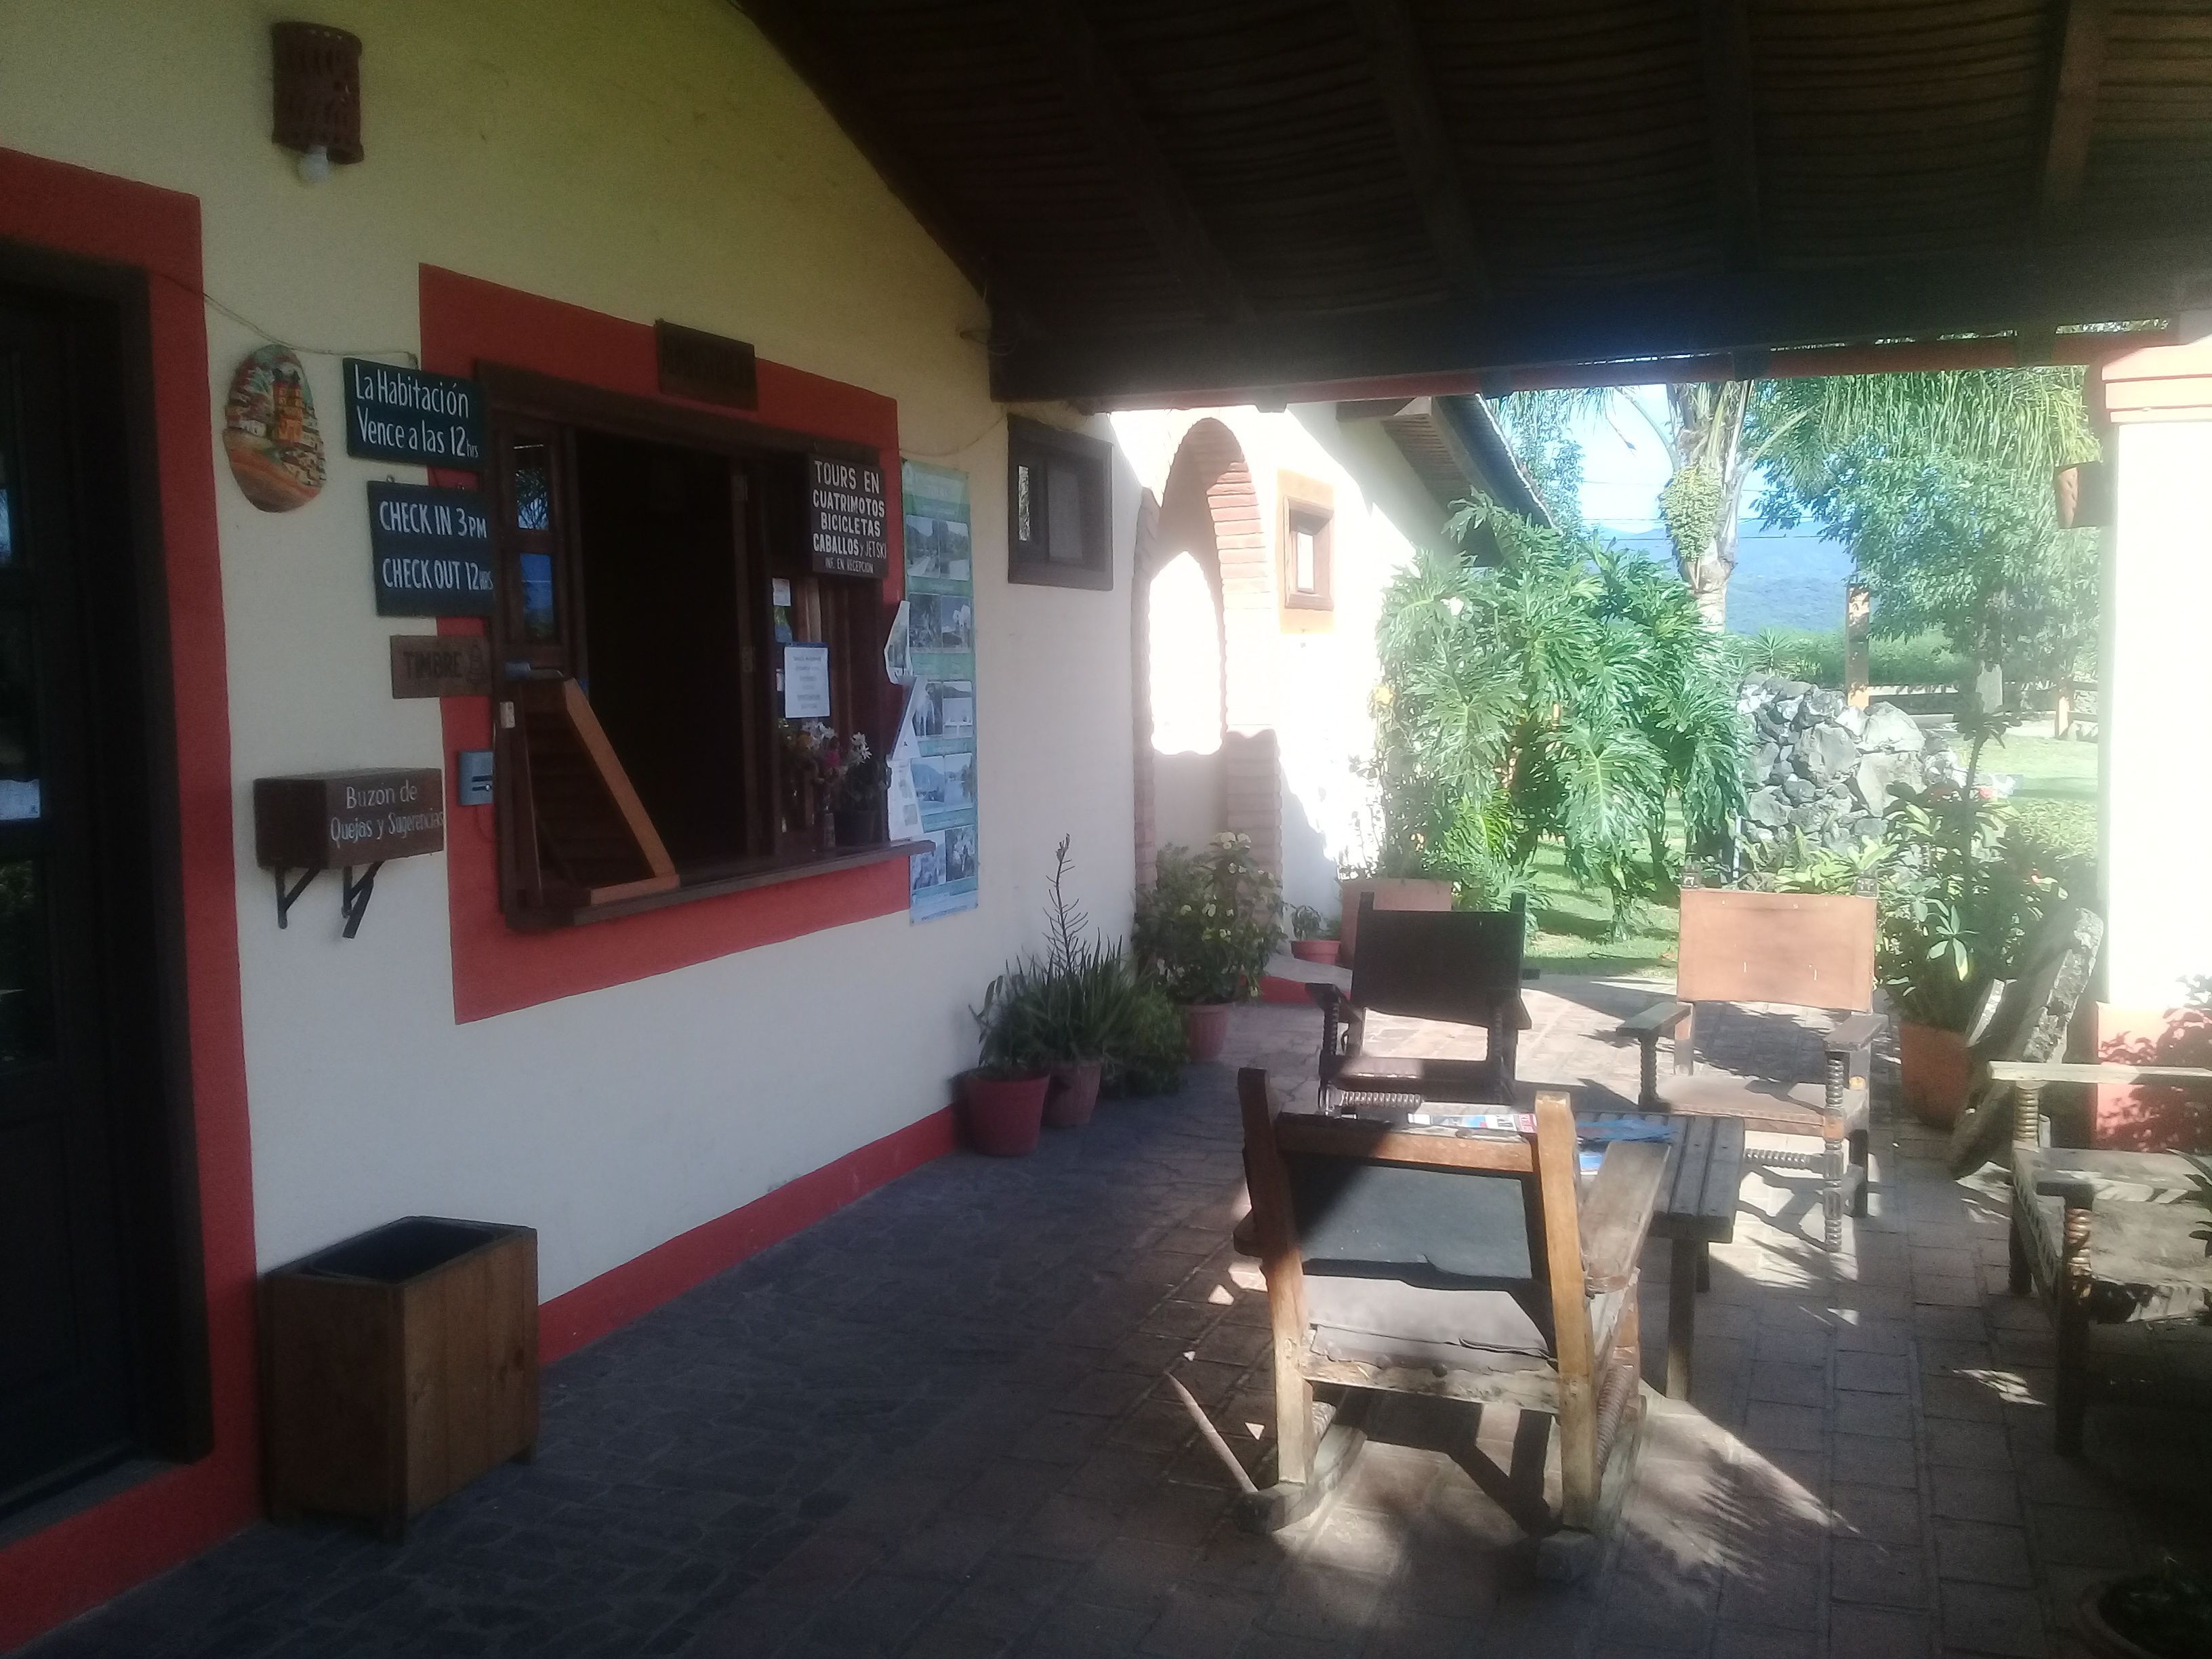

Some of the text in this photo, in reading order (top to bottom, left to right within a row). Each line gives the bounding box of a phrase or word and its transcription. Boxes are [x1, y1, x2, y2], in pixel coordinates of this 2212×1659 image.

[354, 363, 470, 418] La Habitación
[356, 405, 405, 449] Vence
[408, 427, 418, 451] a
[422, 419, 445, 453] las
[814, 460, 880, 494] TOURS EN
[379, 500, 432, 535] CHECK
[434, 505, 453, 536] IN
[813, 489, 885, 518] CUATRIMOTOS
[820, 512, 882, 538] BICICLETAS
[813, 533, 859, 556] CABALLOS
[382, 558, 434, 590] CHECK
[434, 559, 461, 590] OUT
[837, 558, 845, 571] EN
[399, 779, 418, 802] de
[330, 817, 373, 848] Quejas
[375, 818, 384, 840] y
